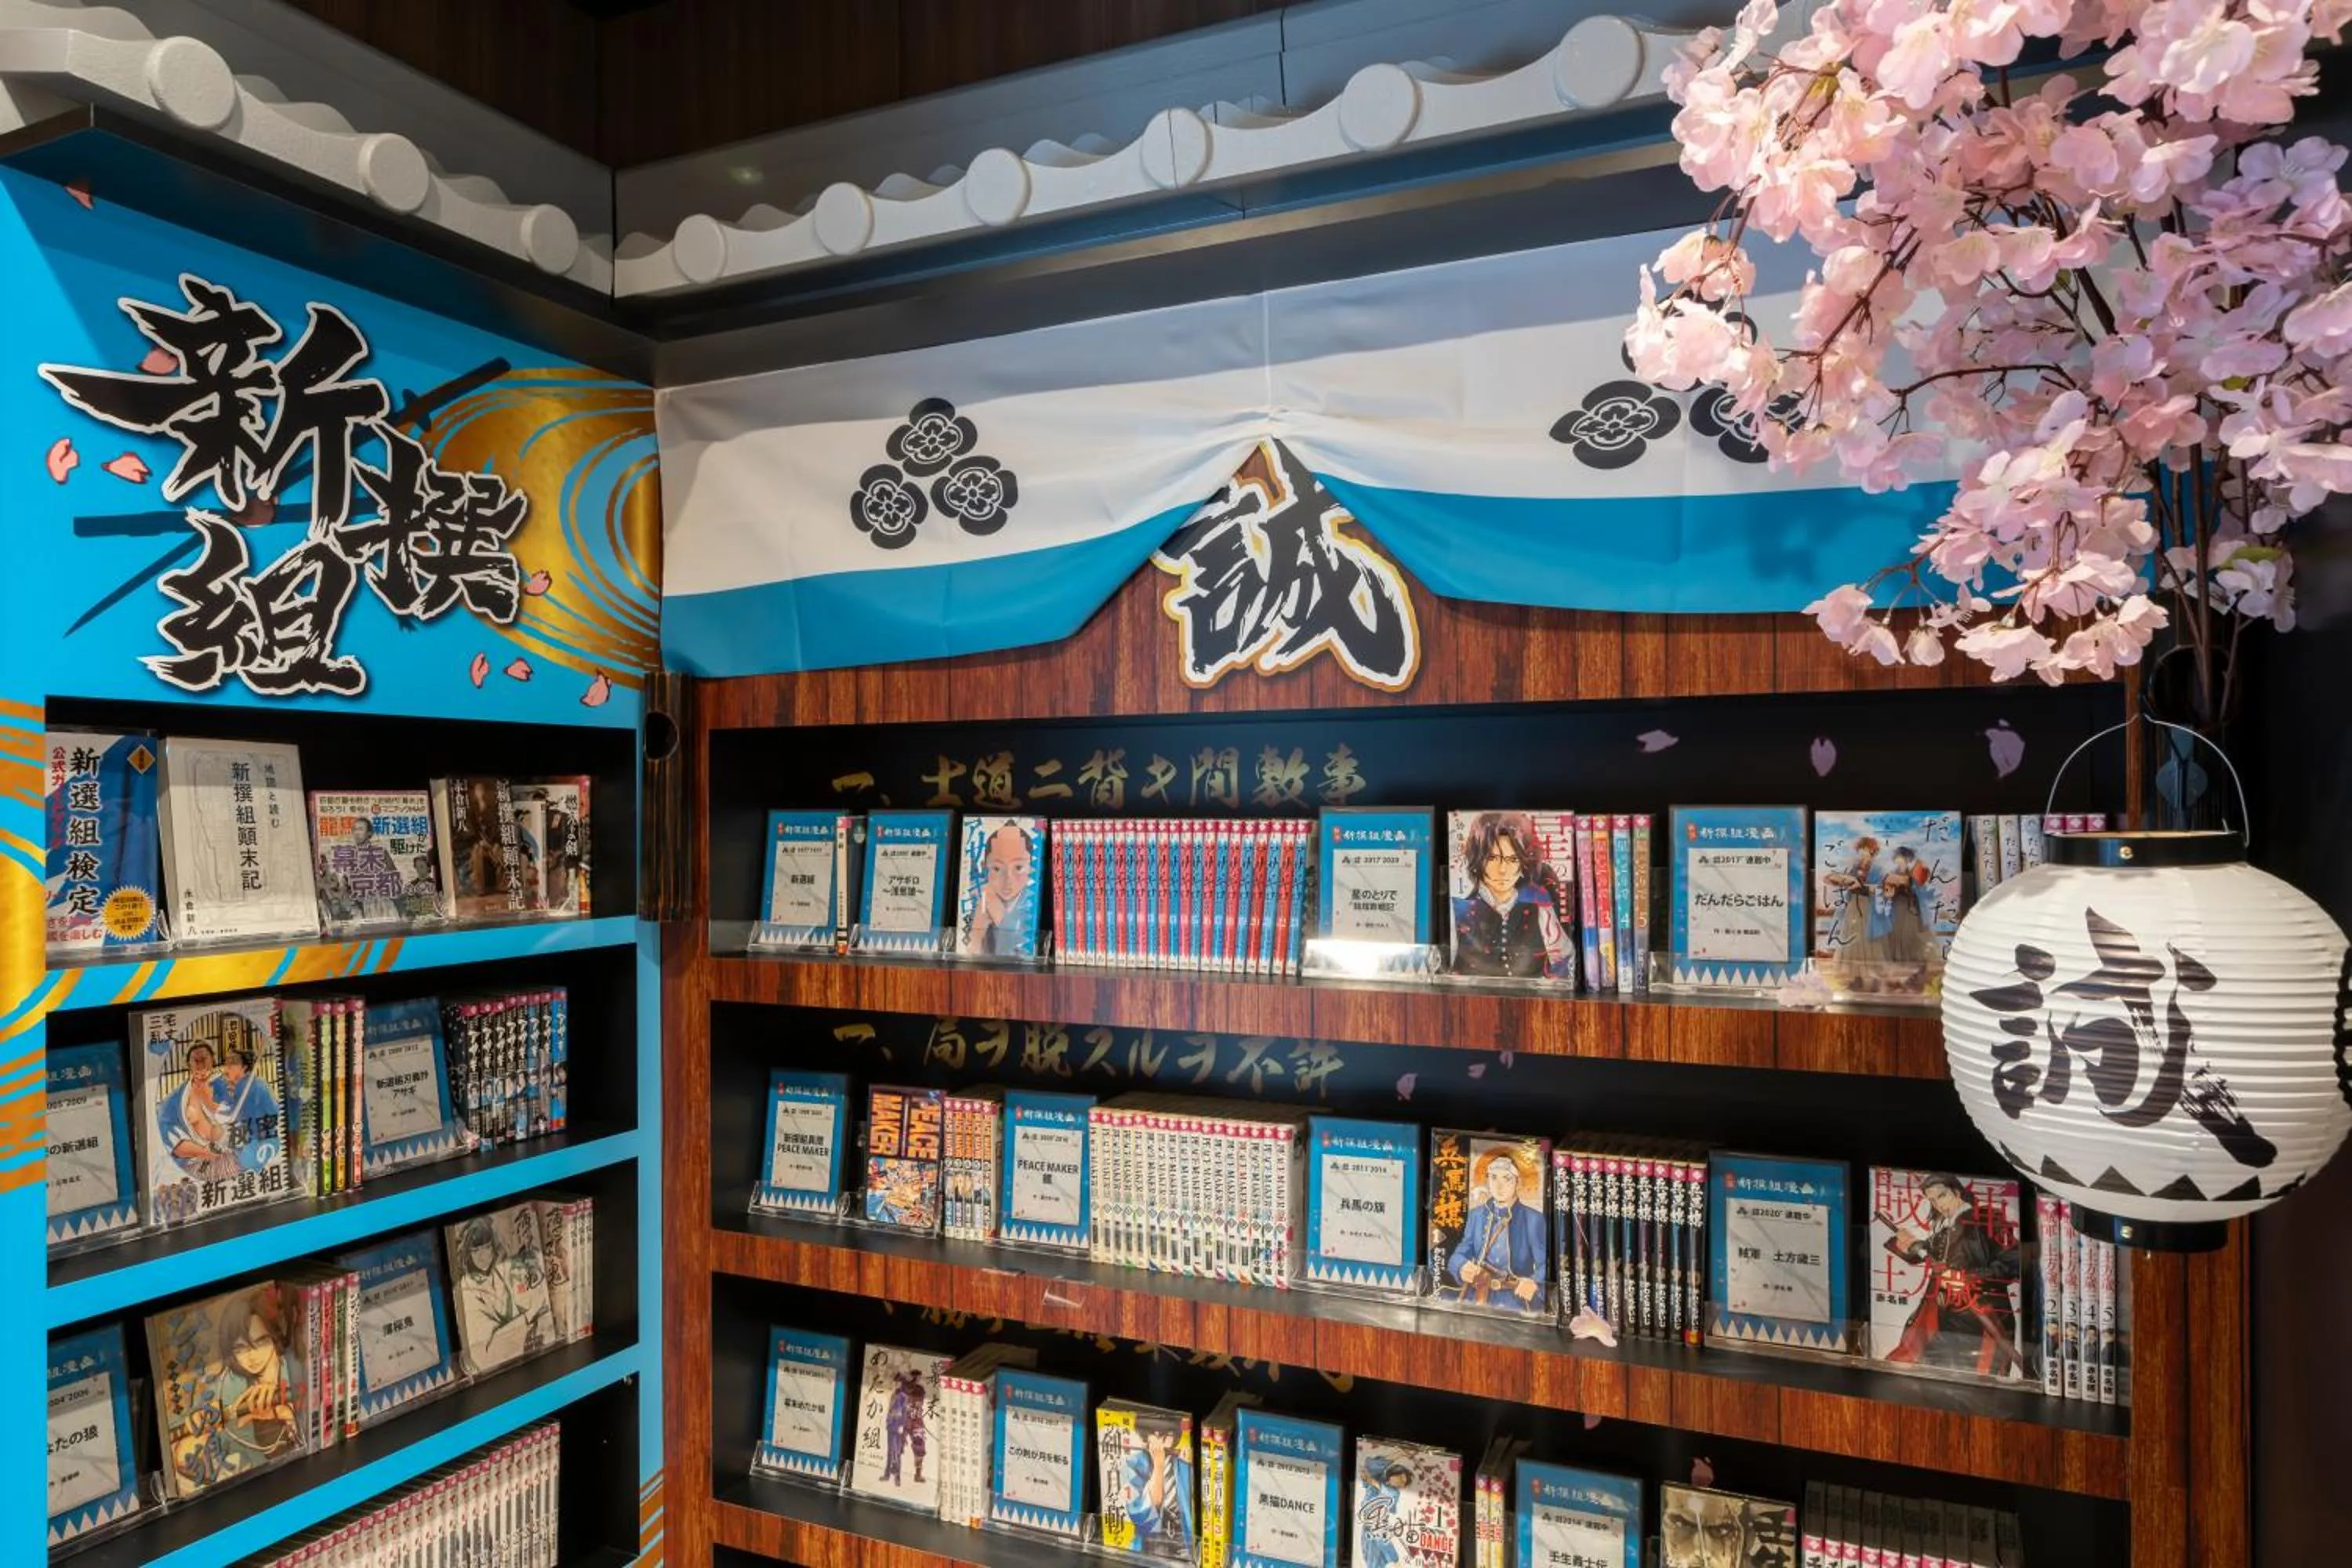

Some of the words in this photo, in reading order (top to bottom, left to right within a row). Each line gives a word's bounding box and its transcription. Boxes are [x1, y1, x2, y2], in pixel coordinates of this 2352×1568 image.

[67, 746, 101, 915] 新選組検定
[1694, 893, 1784, 908] だんだらごはん
[1968, 906, 2278, 1169] 誠
[777, 1143, 800, 1155] PEACE
[800, 1145, 829, 1156] MAKER
[1018, 1160, 1047, 1173] PEACE
[1047, 1161, 1079, 1174] MAKER
[201, 1164, 283, 1209] 新選組
[1773, 1250, 1821, 1267] 土方歳三
[2046, 1299, 2057, 1316] 2
[2067, 1301, 2077, 1318] 3
[2085, 1305, 2096, 1321] 4
[2103, 1307, 2114, 1323] 5
[1258, 1492, 1316, 1515] 黒猫DANCE
[1420, 1532, 1454, 1552] DANCE
